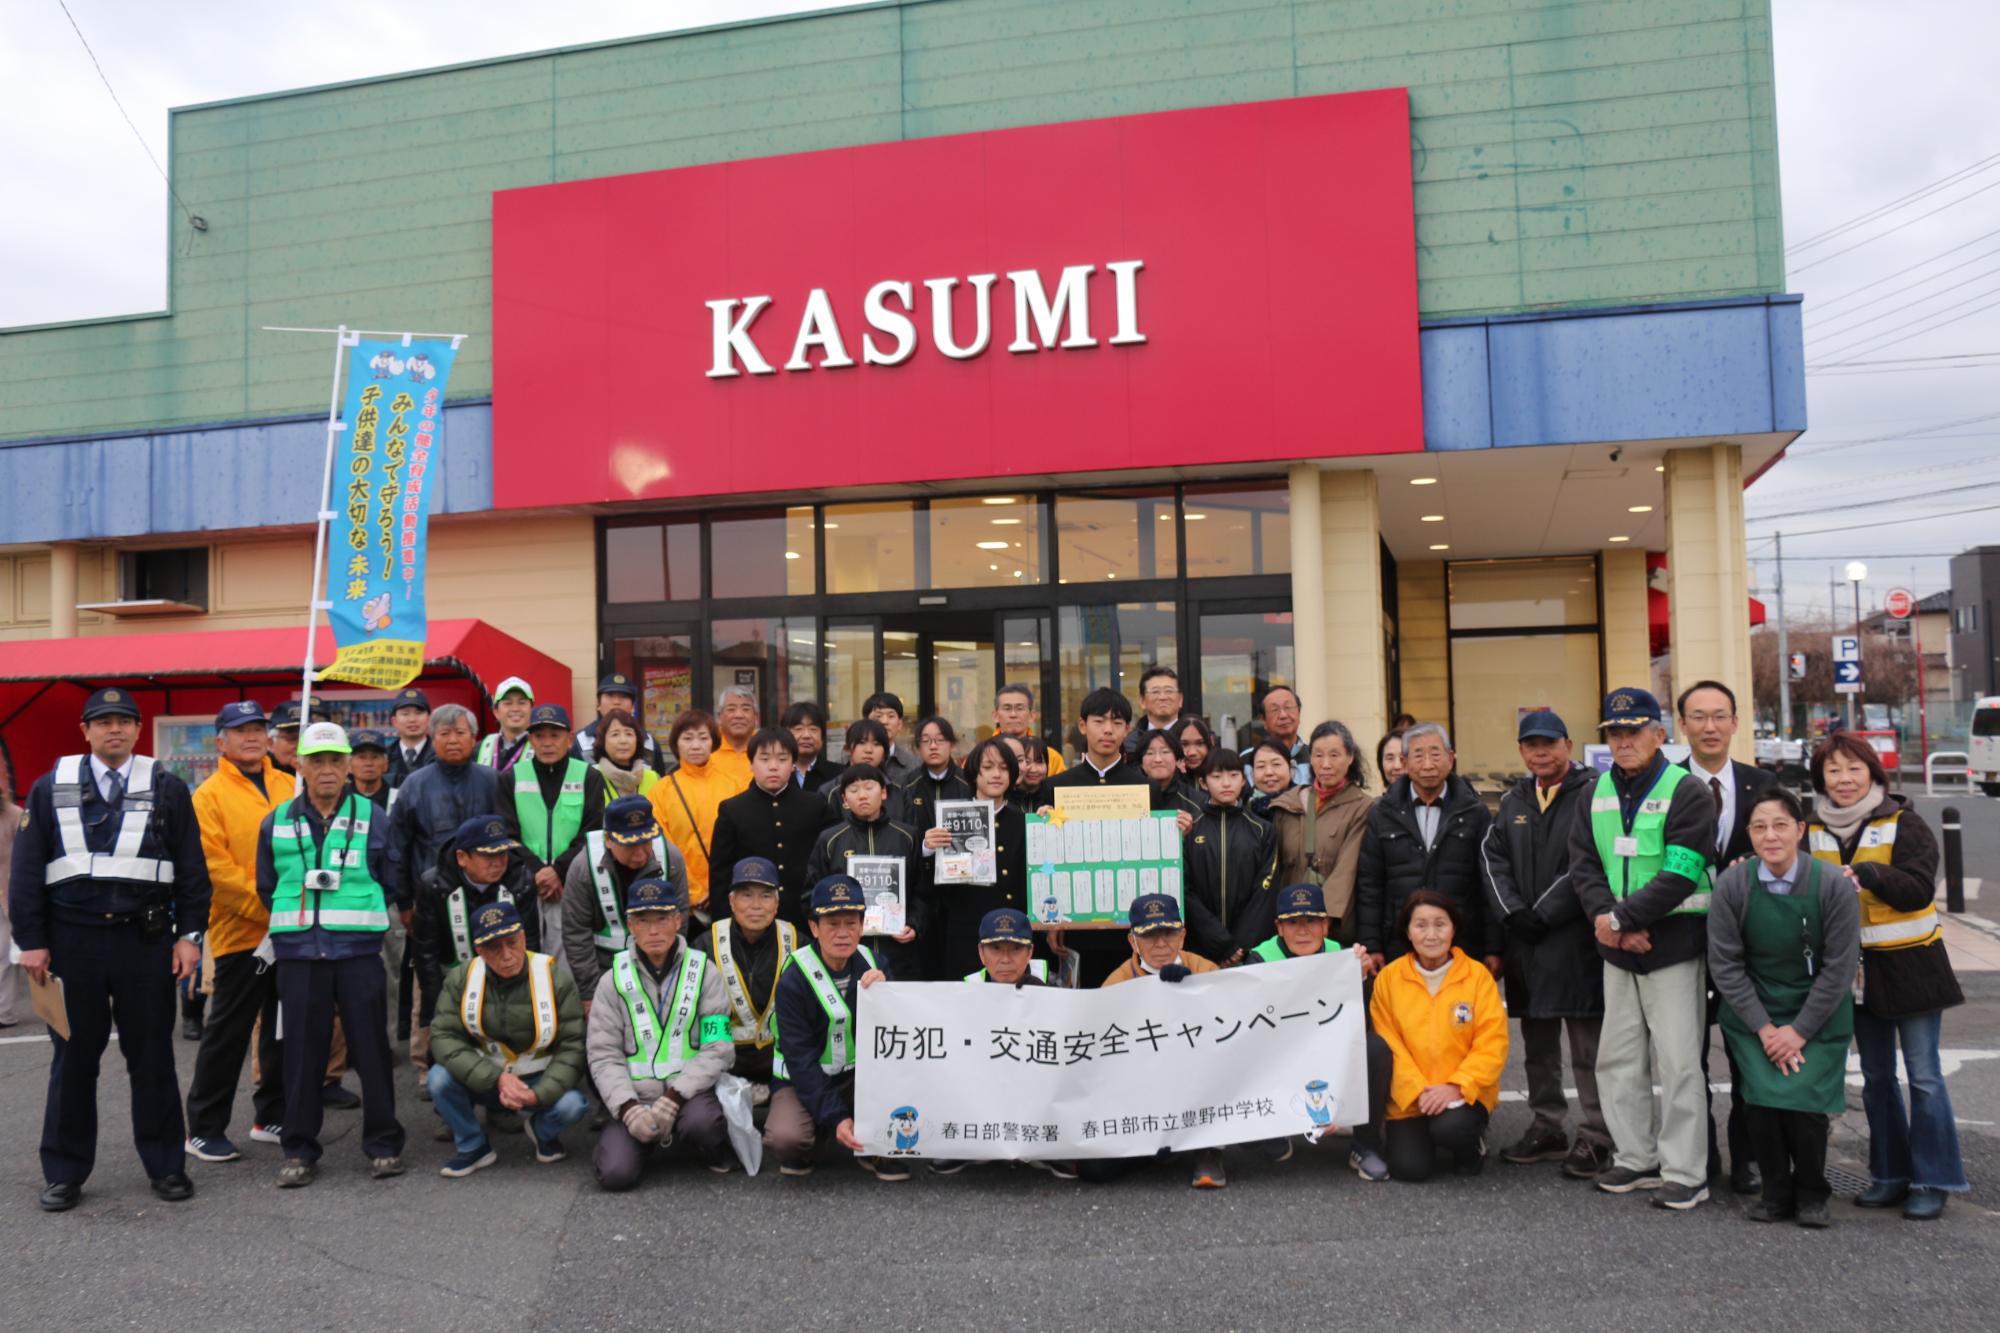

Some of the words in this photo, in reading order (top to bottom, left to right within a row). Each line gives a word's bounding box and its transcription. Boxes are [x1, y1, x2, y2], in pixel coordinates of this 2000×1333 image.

[704, 260, 1149, 378] KASUMI
[344, 385, 382, 600] 子供達の大切な未来
[377, 393, 415, 580] みんなで守ろう!
[1841, 640, 1857, 657] P
[671, 958, 700, 1038] 防犯パトロール
[873, 999, 1344, 1066] 防犯・交通安全キャンペーン
[941, 1121, 1060, 1142] 春日部警察署
[1080, 1097, 1276, 1140] 春日部市立豊野中学校
